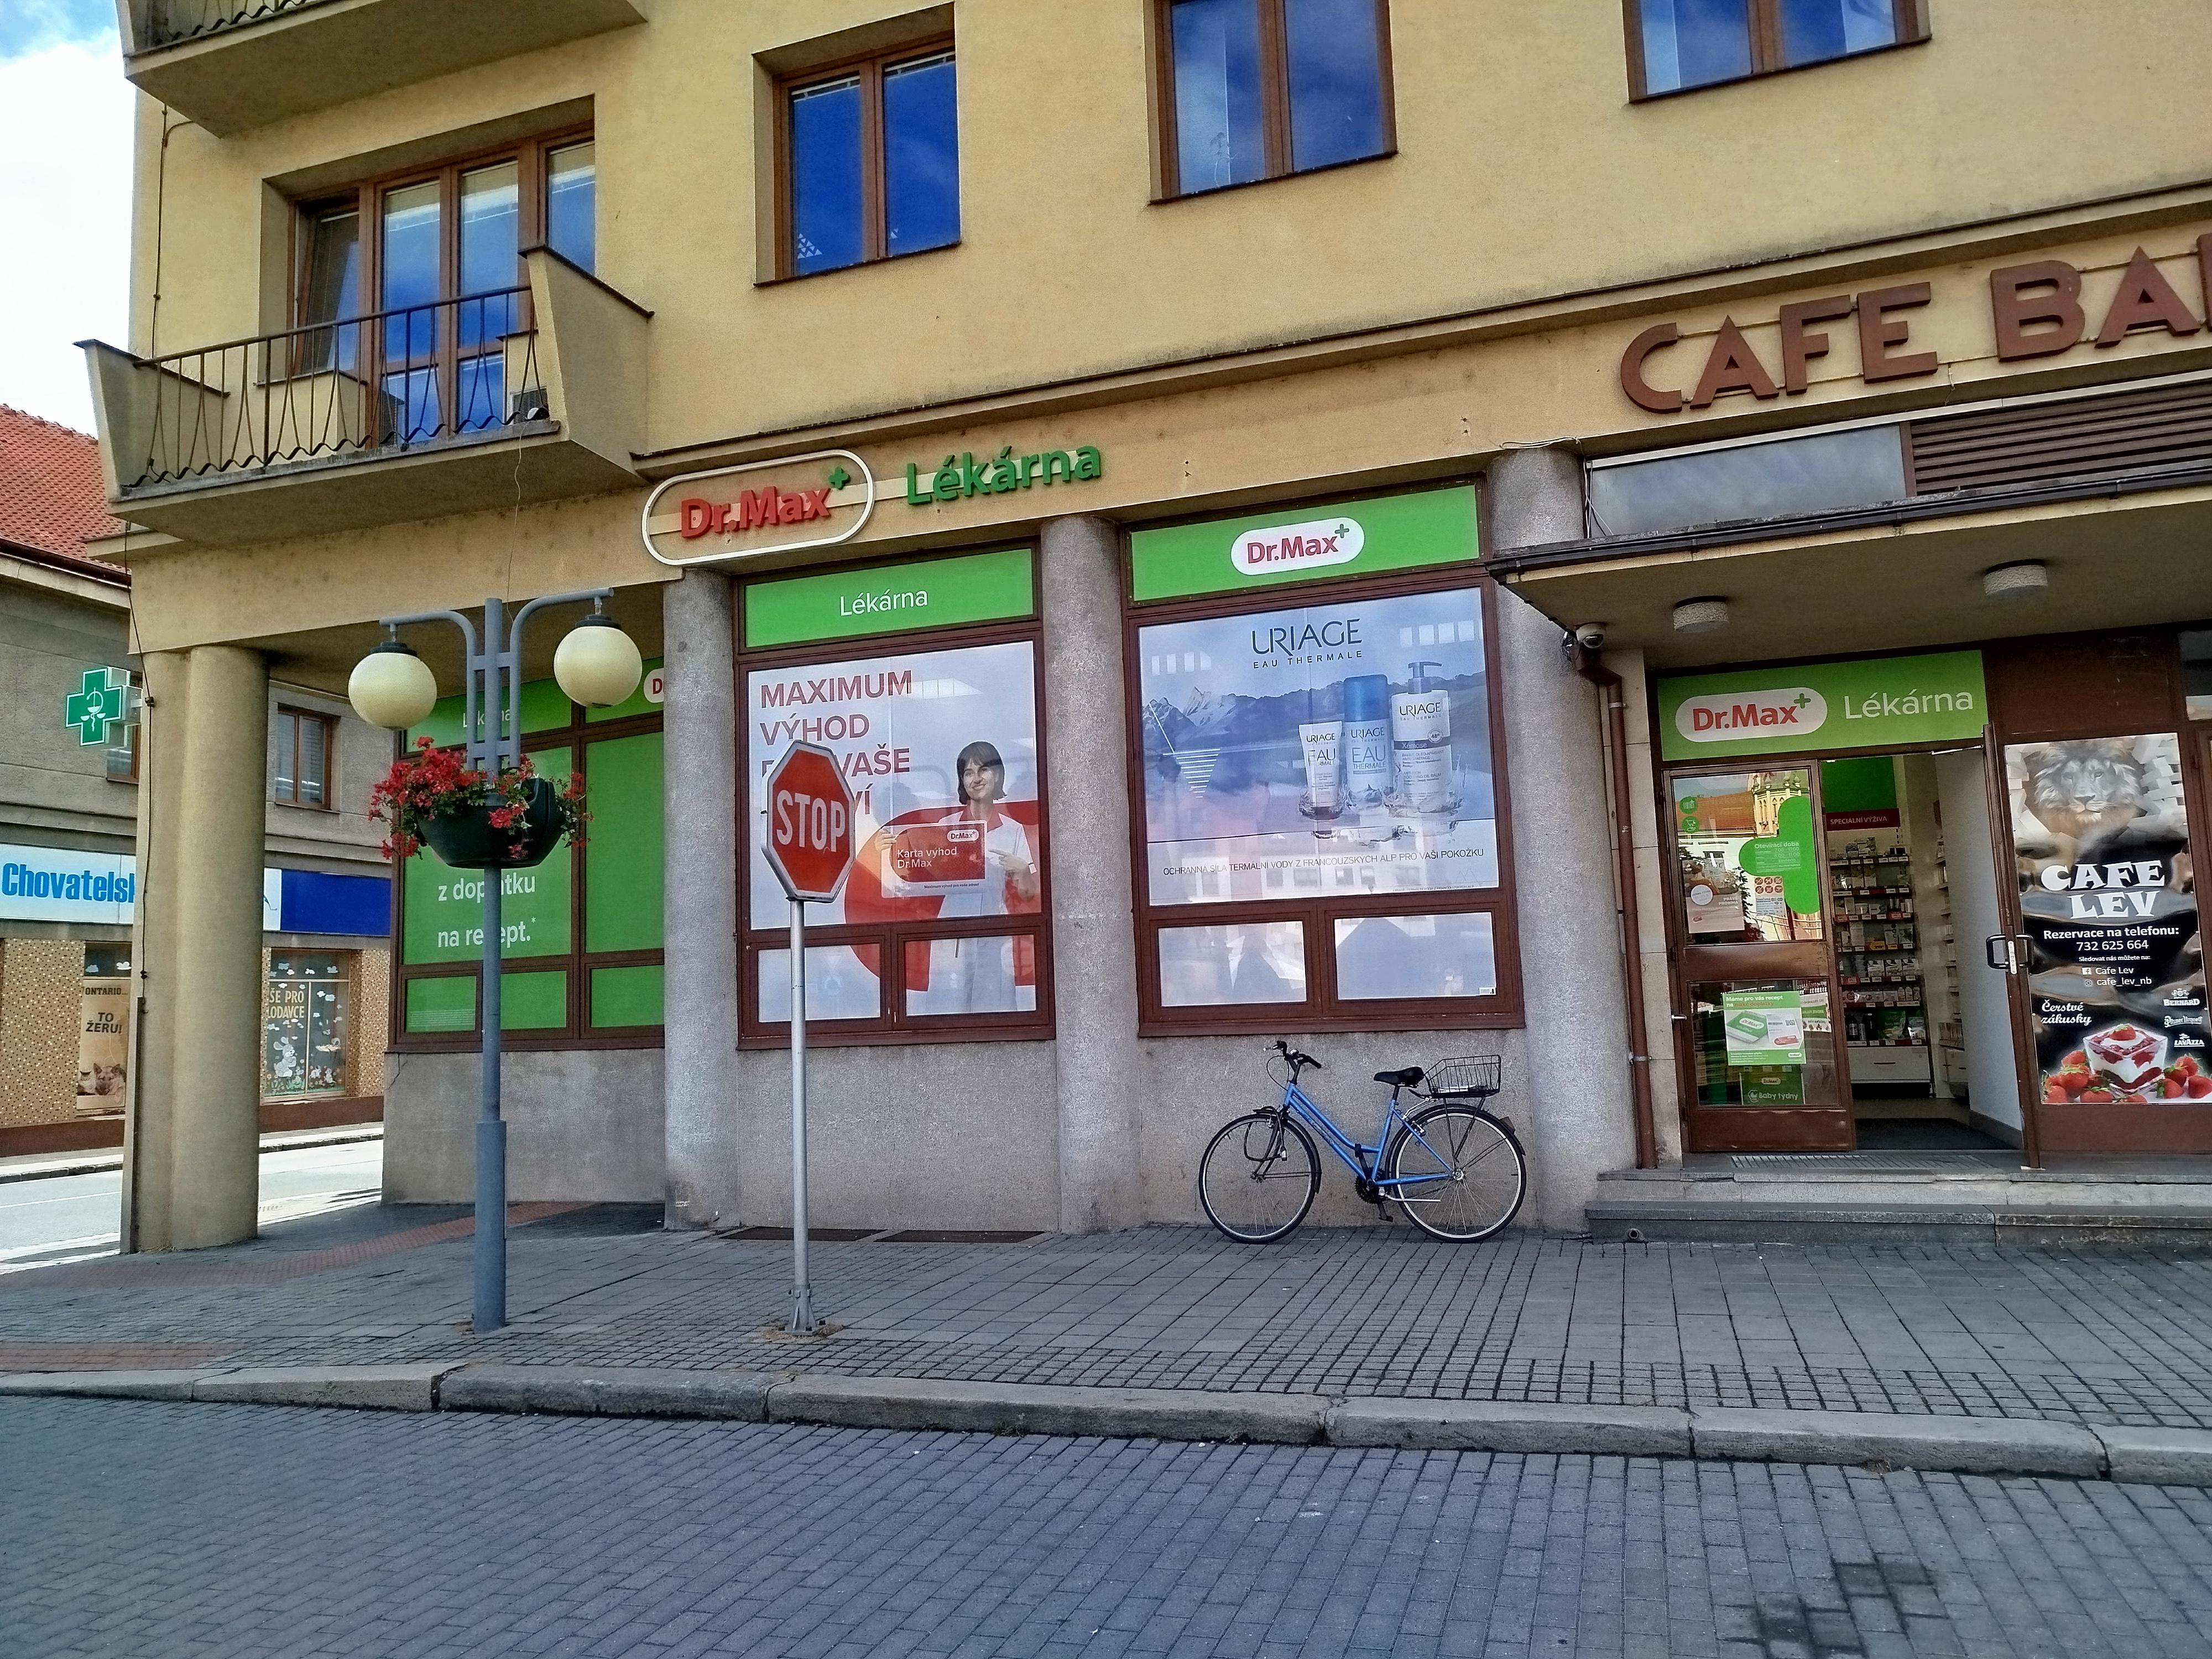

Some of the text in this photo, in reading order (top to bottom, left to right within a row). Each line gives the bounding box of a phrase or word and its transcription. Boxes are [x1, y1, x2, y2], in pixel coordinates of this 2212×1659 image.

[1620, 232, 2212, 414] CAFE BA
[906, 446, 1101, 505] Lékárna
[839, 587, 928, 617] Lékárna
[1251, 618, 1362, 656] URIAGE
[1254, 650, 1363, 669] EAU THERMALE
[760, 670, 912, 709] MAXIMUM
[1400, 702, 1441, 717] URIAGE
[1844, 689, 1974, 719] Lékárna
[759, 713, 870, 746] VÝHOD
[1306, 733, 1335, 743] URIAGE
[1351, 727, 1385, 739] URIAGE
[1352, 745, 1386, 763] EAU
[1353, 761, 1386, 770] THERMALE
[776, 789, 846, 853] STOP
[897, 847, 957, 858] Karta výhod
[1229, 860, 1269, 872] TERMÁLNÍ
[1271, 859, 1293, 869] VODY
[1303, 854, 1378, 868] FRANCOUZSKÝCH
[1420, 849, 1438, 859] VAŠI
[1441, 847, 1484, 859] POKOŽKU
[2041, 860, 2165, 891] CAFE
[438, 872, 535, 903] z doptku
[2067, 890, 2160, 919] LEV
[438, 930, 460, 948] na
[2043, 929, 2104, 940] Rezervace
[2124, 926, 2179, 936] telefonu:
[2077, 940, 2149, 951] 732 625 664
[2096, 976, 2152, 987] cafe_lev_nb
[285, 990, 304, 1003] PRO
[2042, 999, 2084, 1013] Čerstvé
[98, 1012, 114, 1022] TO
[2041, 1013, 2093, 1026] zákusky
[86, 1020, 123, 1034] ŽERU!
